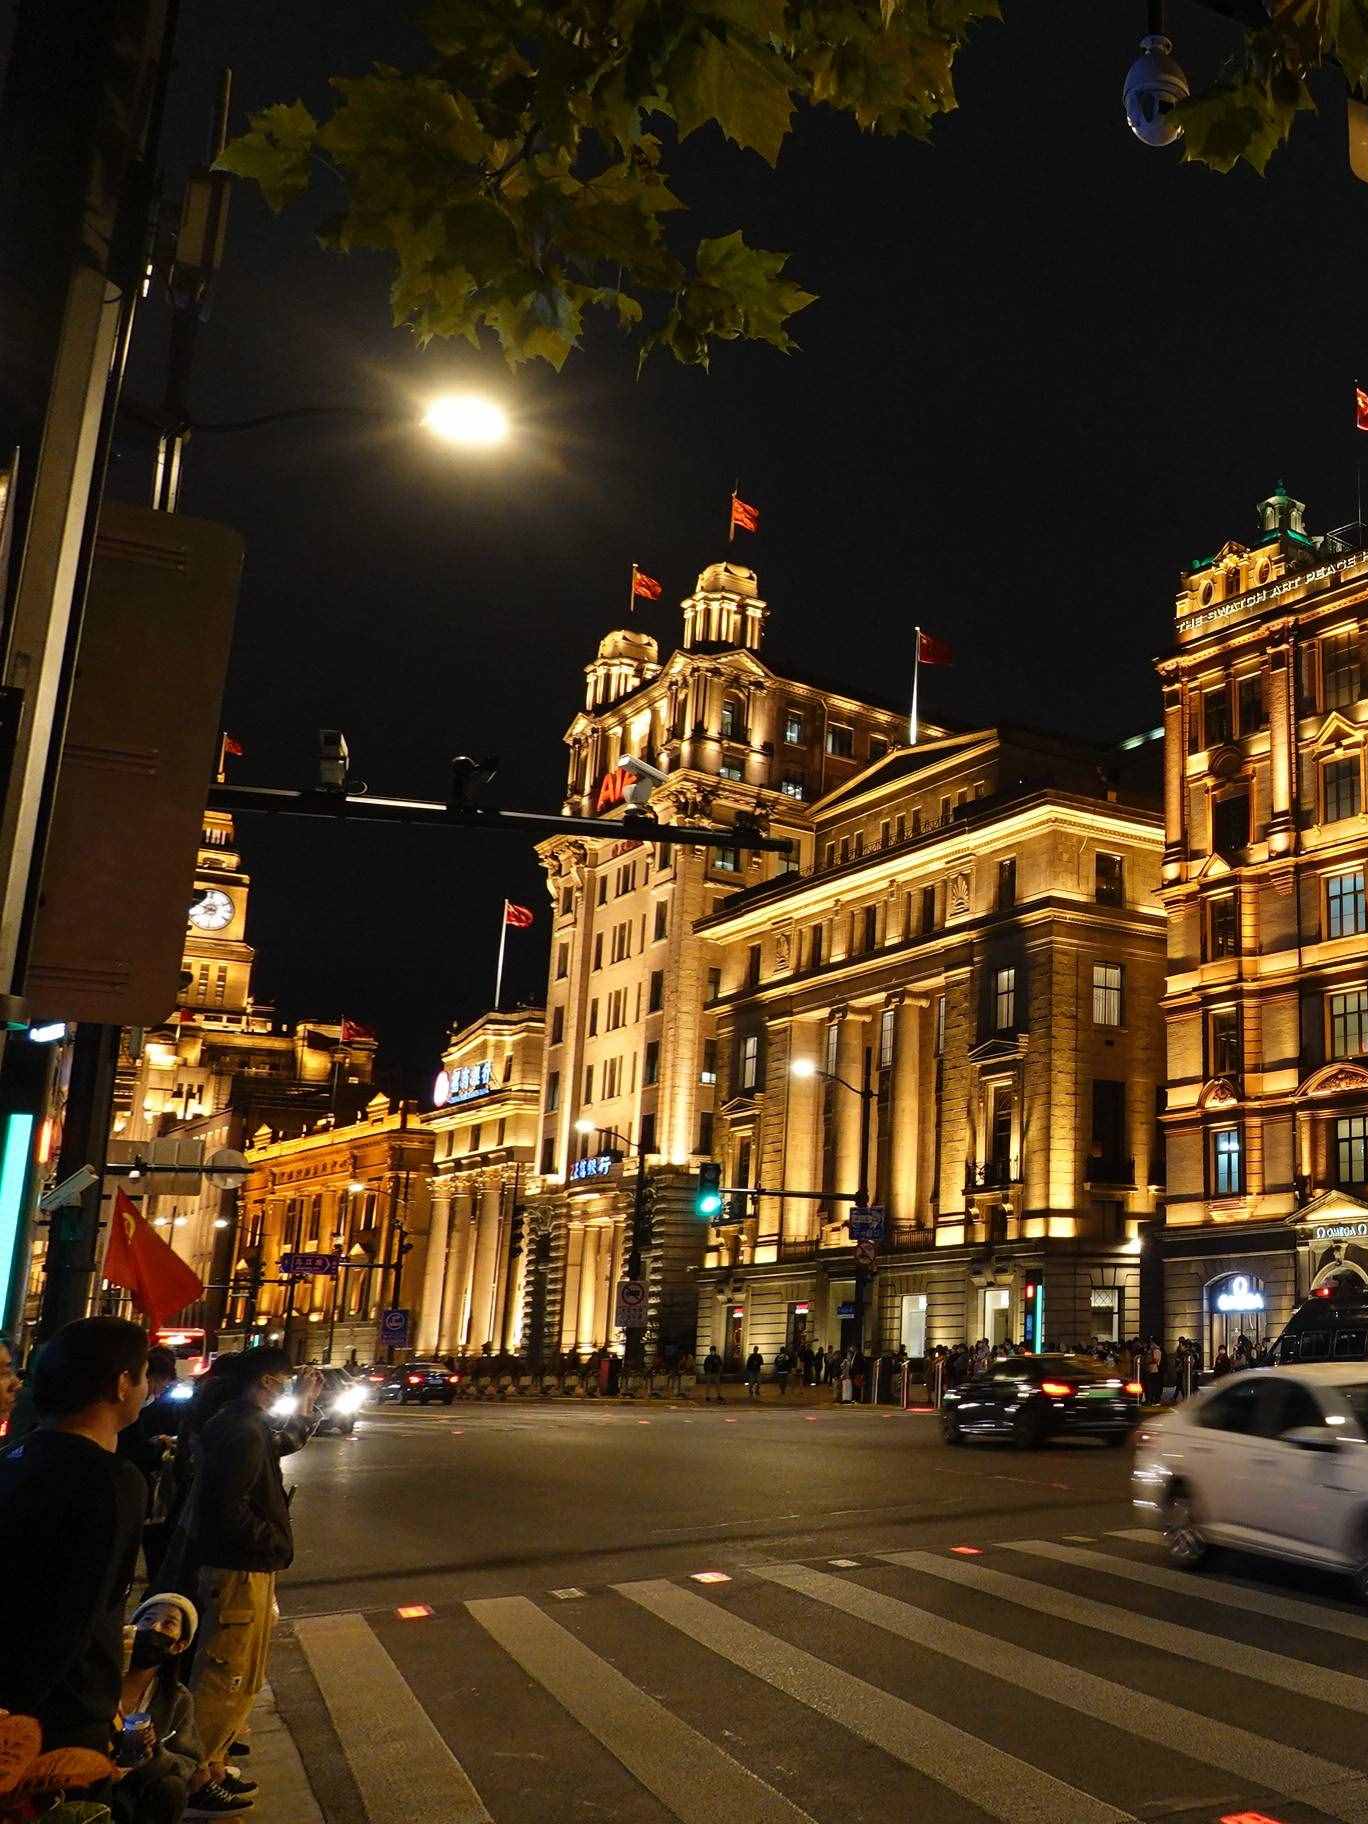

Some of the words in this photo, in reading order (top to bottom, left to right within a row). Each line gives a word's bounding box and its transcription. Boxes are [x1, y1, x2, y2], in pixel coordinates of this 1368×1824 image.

[1176, 613, 1206, 634] THE
[1207, 589, 1267, 621] SWATCH
[1270, 576, 1301, 599] ART
[1304, 555, 1357, 585] PEACE
[1326, 1226, 1357, 1238] OMEGA
